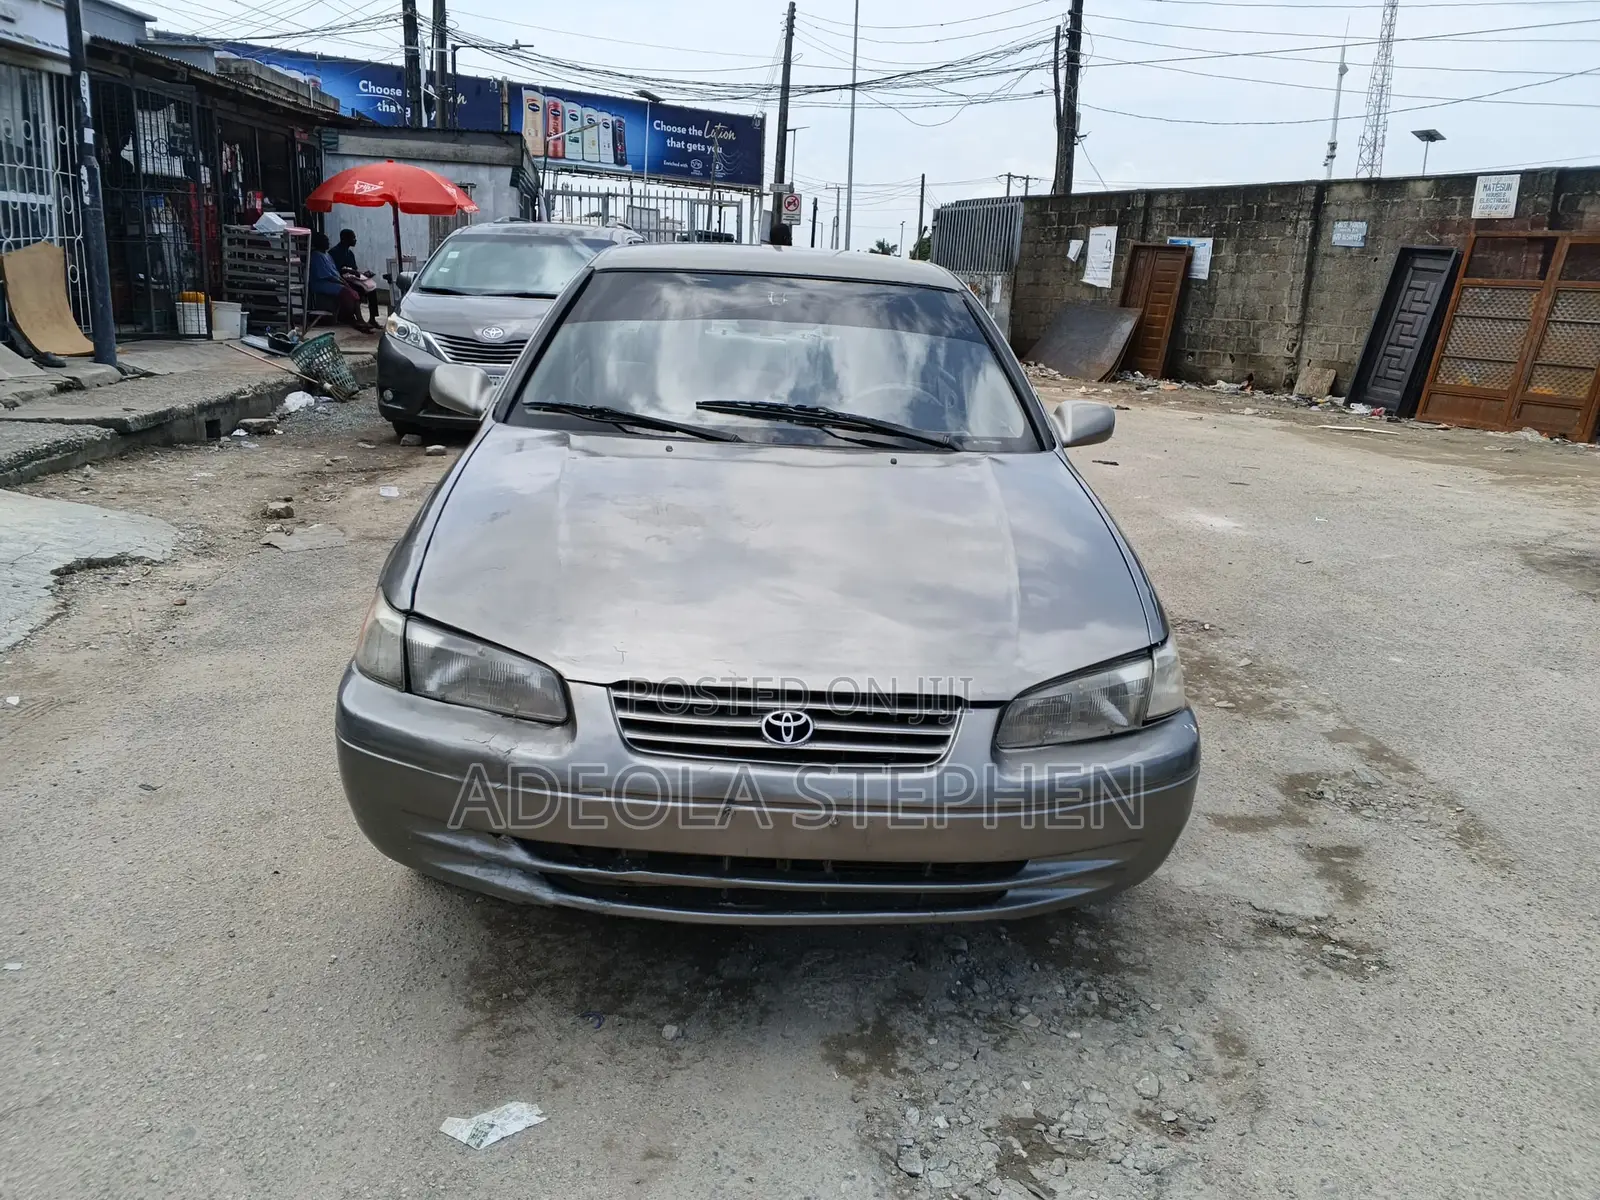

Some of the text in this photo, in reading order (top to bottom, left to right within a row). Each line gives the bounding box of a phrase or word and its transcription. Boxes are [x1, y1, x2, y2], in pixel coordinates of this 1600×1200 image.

[358, 80, 403, 97] Choose
[653, 120, 737, 140] Choose the Lotion
[666, 136, 685, 149] that
[686, 142, 706, 153] gets
